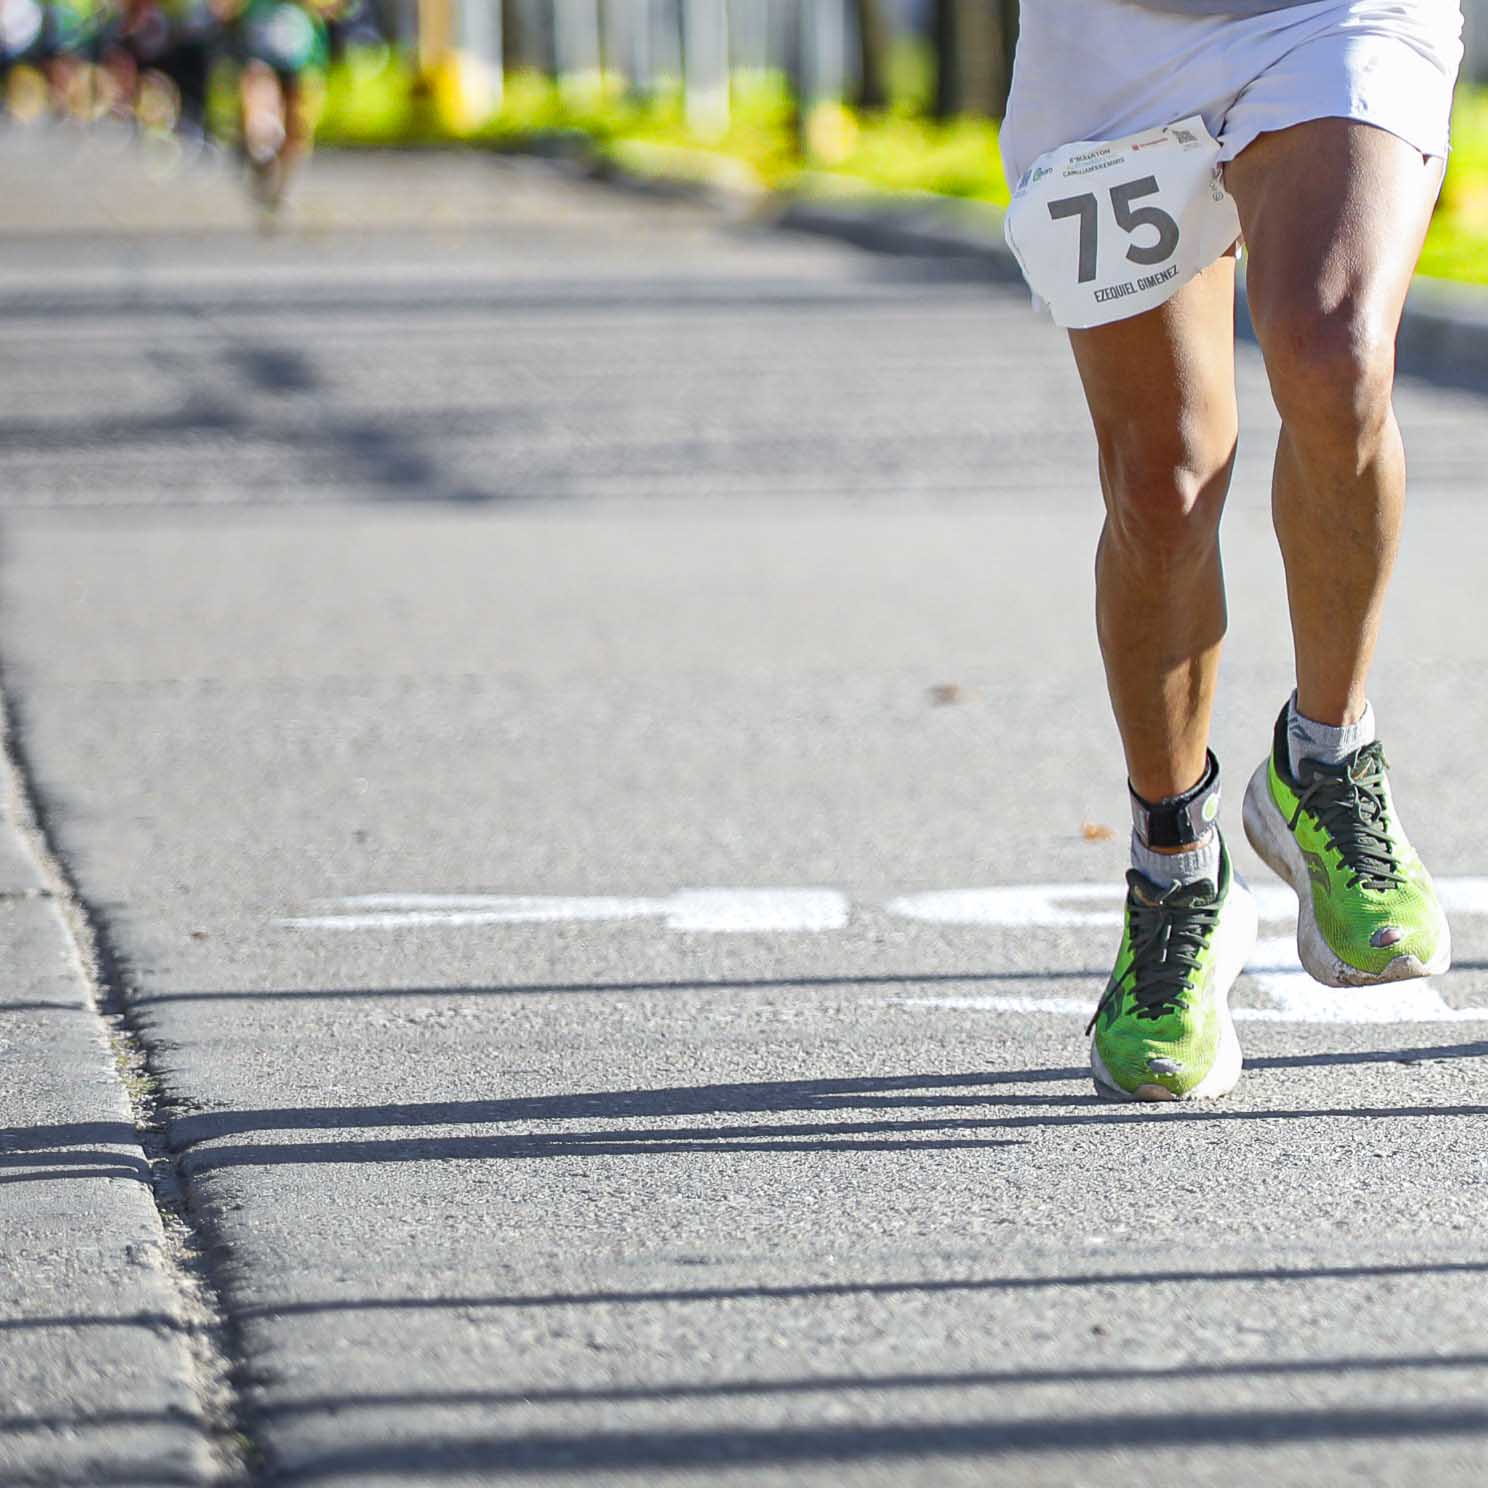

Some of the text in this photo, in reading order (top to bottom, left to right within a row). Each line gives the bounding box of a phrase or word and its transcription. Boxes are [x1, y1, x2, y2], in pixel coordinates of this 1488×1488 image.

[1047, 174, 1180, 284] 75
[1094, 264, 1179, 303] EZEQUIEL GIMENEZ
